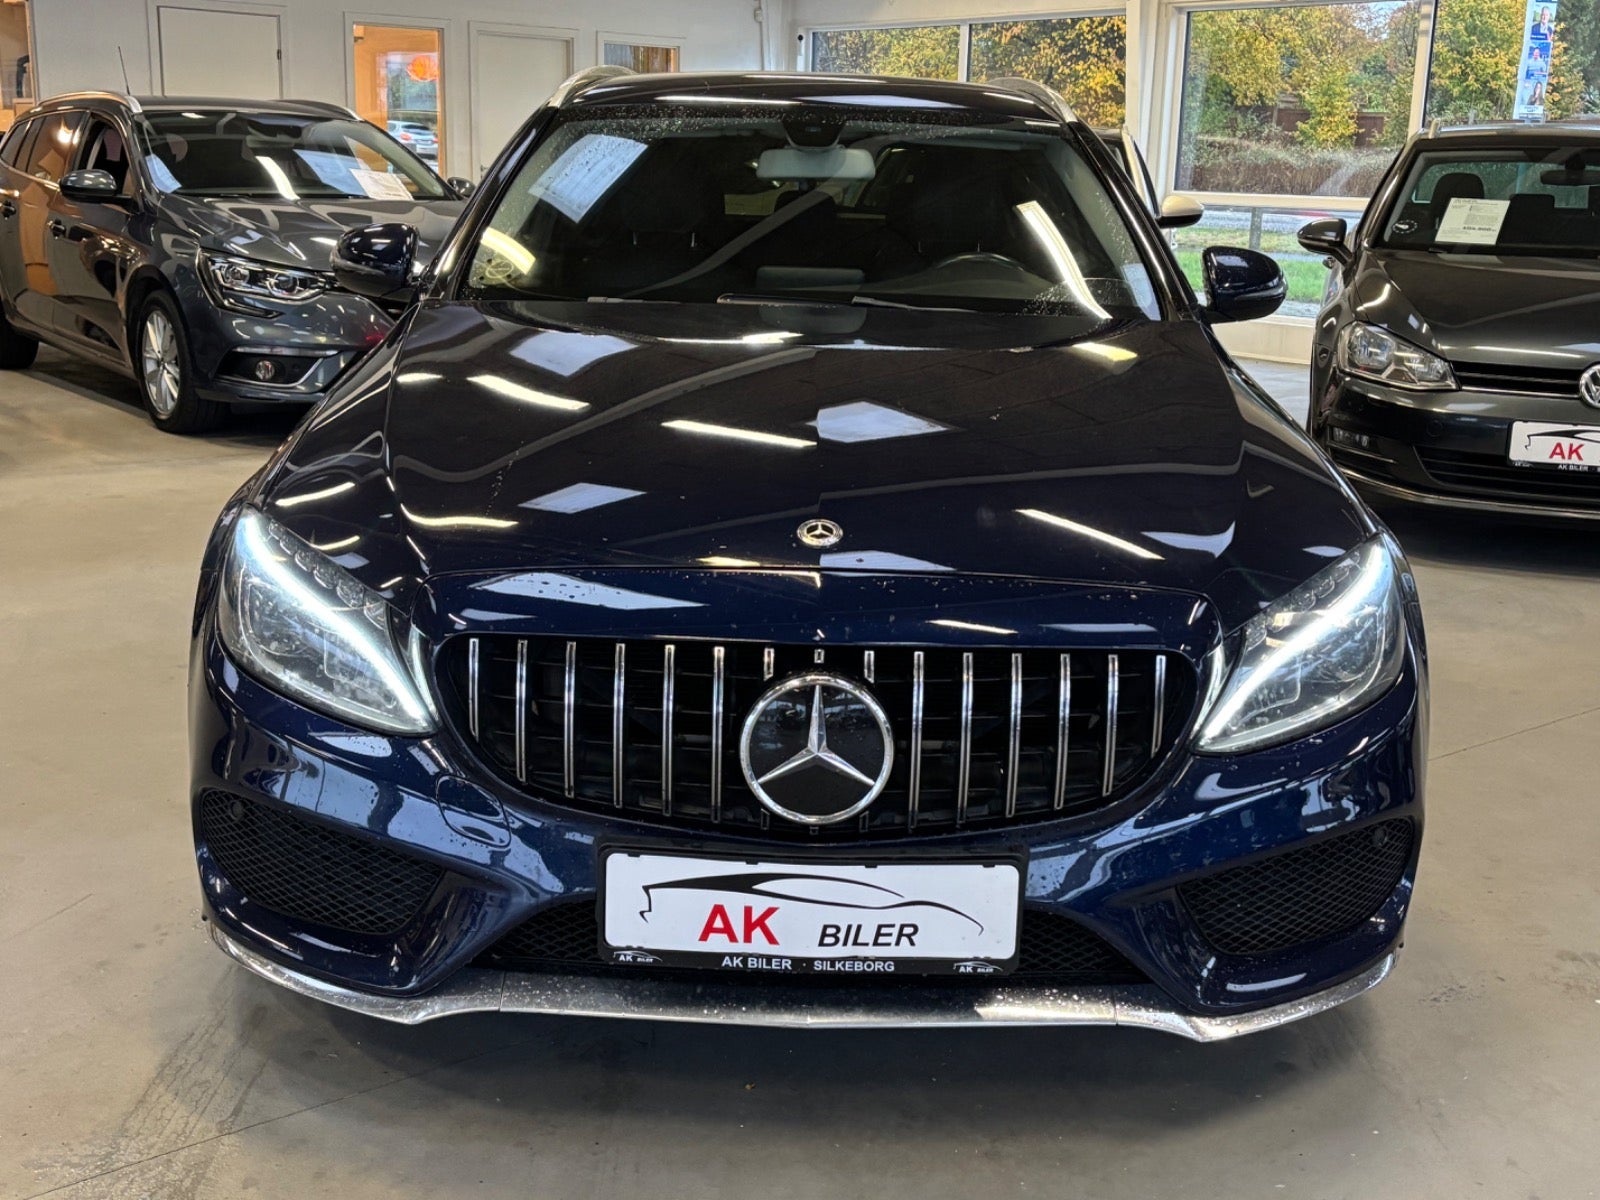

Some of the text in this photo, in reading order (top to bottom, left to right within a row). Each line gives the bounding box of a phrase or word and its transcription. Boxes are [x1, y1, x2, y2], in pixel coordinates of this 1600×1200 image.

[1549, 442, 1585, 461] AK
[698, 903, 920, 948] AK BILER
[721, 956, 895, 972] AK BILER SILKEBORG
